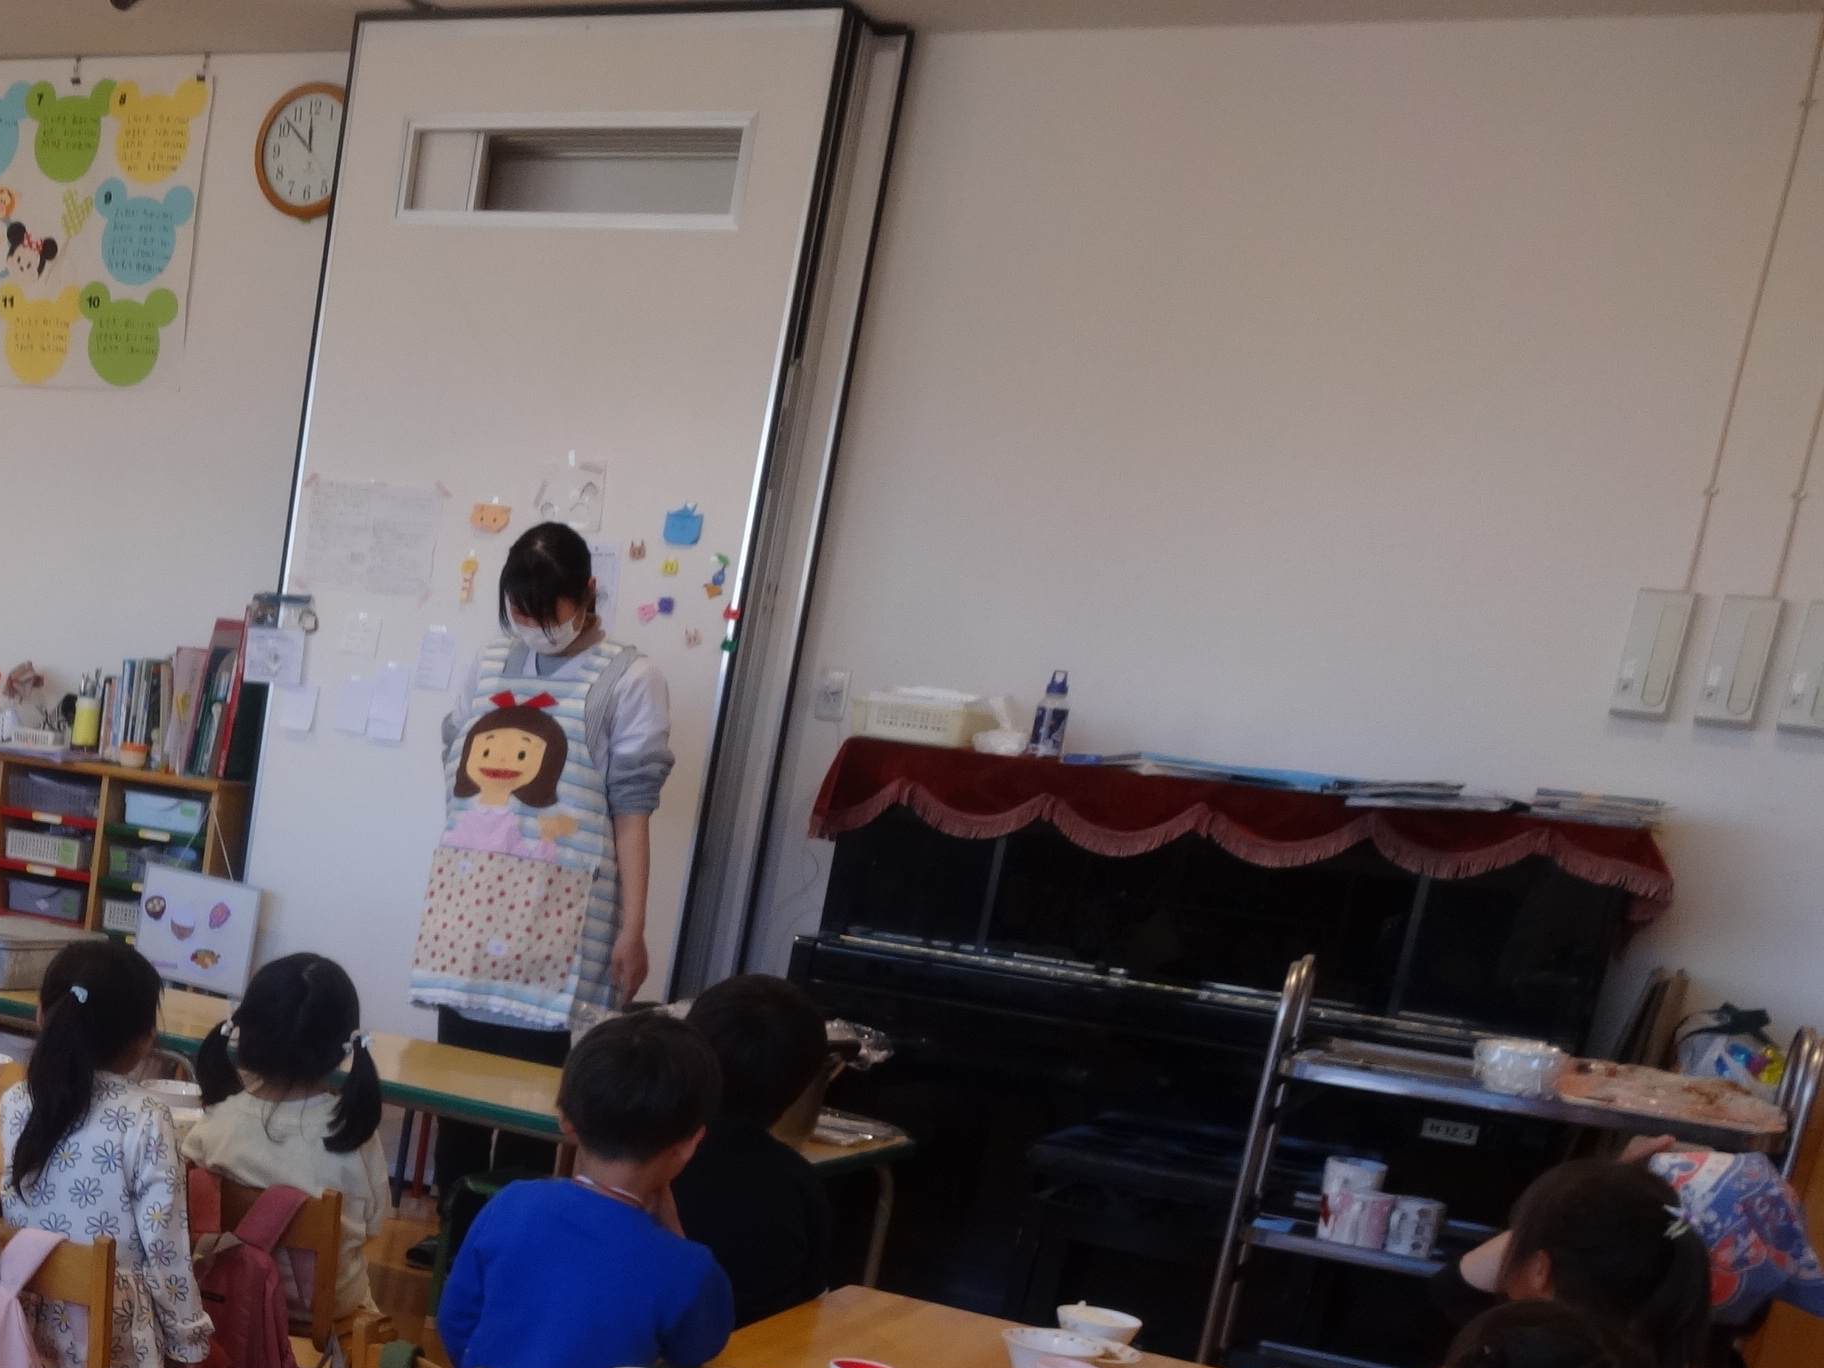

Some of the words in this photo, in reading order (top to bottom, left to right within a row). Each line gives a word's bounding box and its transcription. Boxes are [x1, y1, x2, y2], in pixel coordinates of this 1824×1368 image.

[36, 92, 44, 106] 7
[118, 93, 127, 106] 8
[294, 106, 303, 122] 11
[309, 100, 322, 116] 12
[278, 120, 291, 138] 10
[272, 143, 281, 160] 9
[275, 164, 284, 181] 8
[288, 180, 295, 196] 7
[302, 184, 311, 200] 6
[320, 179, 328, 195] 5
[104, 191, 112, 205] 9
[1, 295, 15, 309] 11
[86, 295, 100, 309] 10
